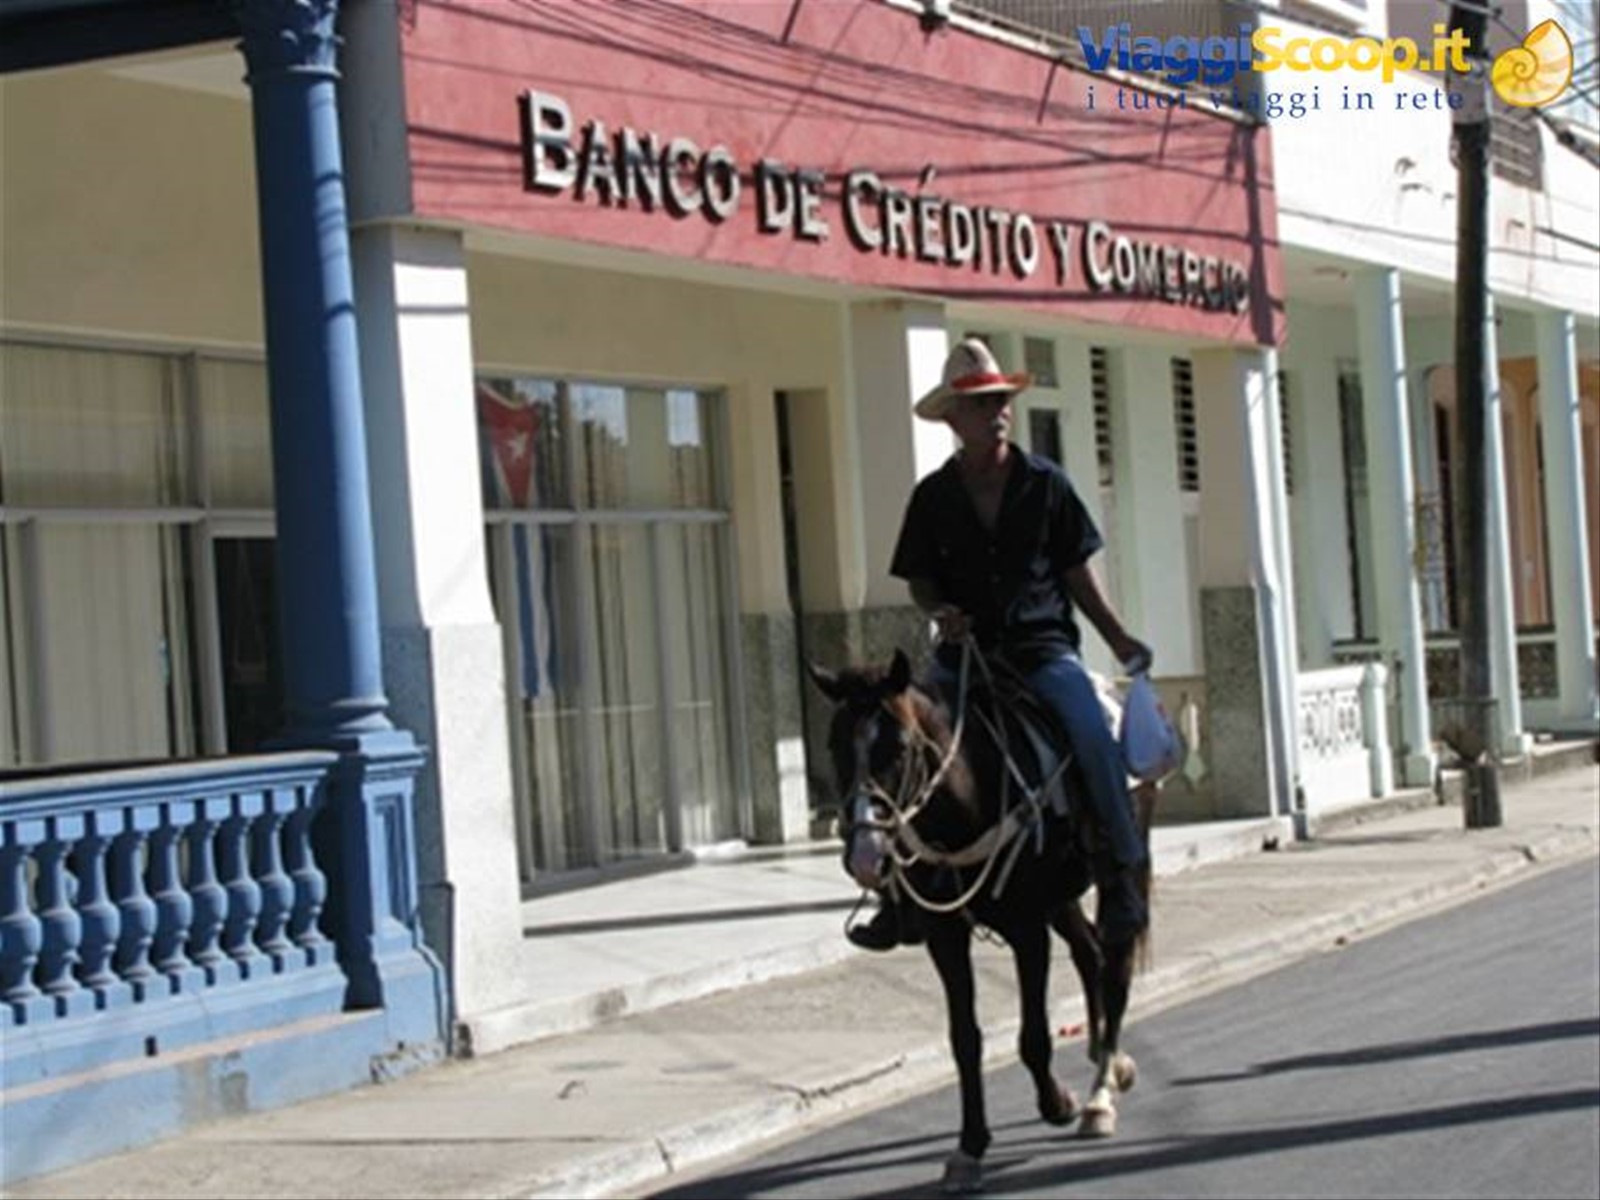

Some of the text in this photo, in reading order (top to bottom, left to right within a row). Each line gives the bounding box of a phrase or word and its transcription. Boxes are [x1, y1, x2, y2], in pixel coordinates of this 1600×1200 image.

[519, 89, 1250, 314] BANCO DE CRÉDITO Y COMERCIO
